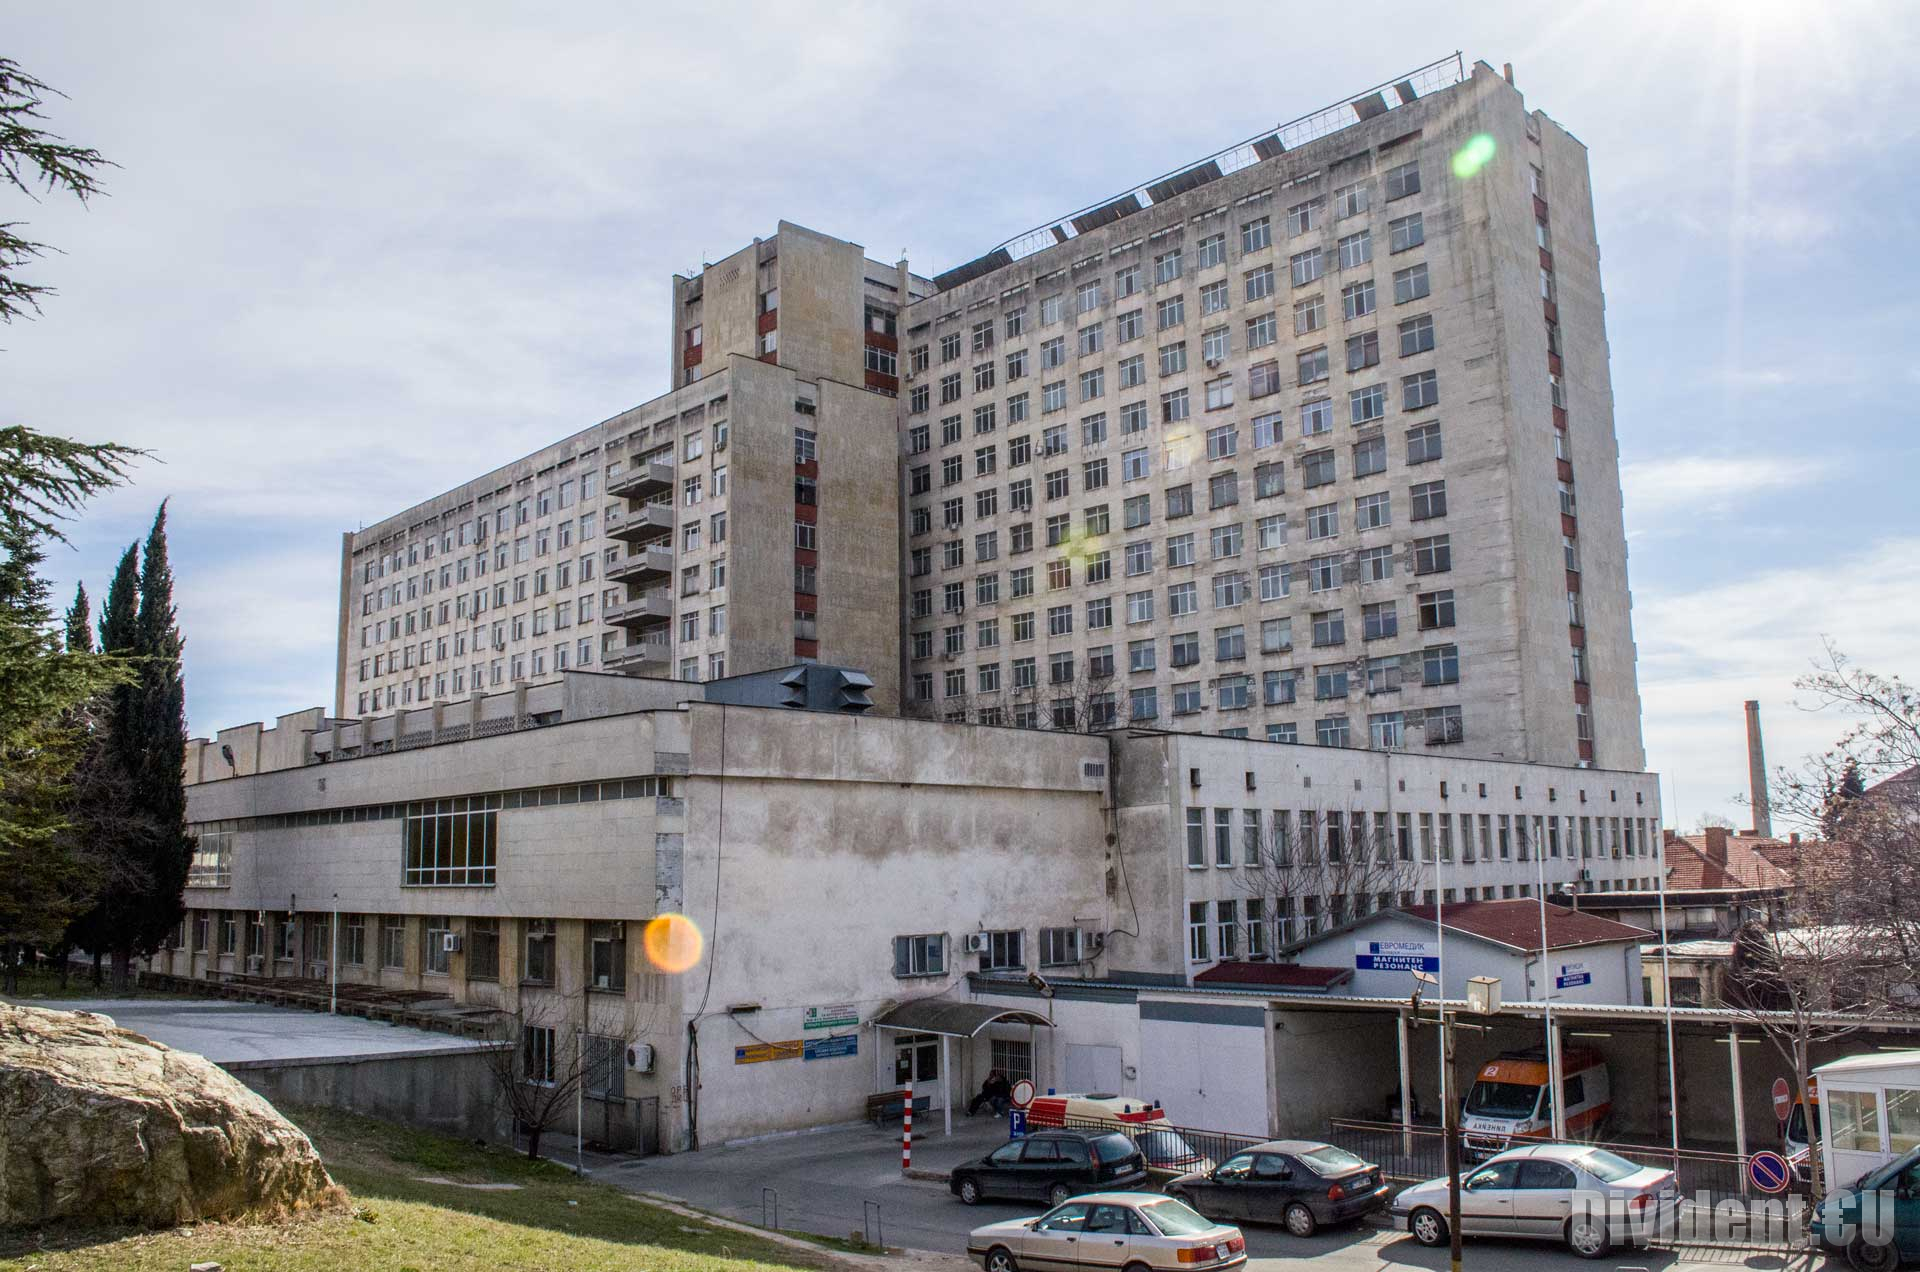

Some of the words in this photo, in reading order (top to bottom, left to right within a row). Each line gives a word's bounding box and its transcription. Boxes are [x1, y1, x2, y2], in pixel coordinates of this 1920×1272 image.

[1381, 942, 1425, 950] ЕВРОМЕДИК
[1373, 956, 1423, 964] МАГНИТЕН
[1373, 963, 1424, 971] РЕЗОНАНС
[1486, 1066, 1496, 1076] 2
[1013, 1112, 1021, 1130] P
